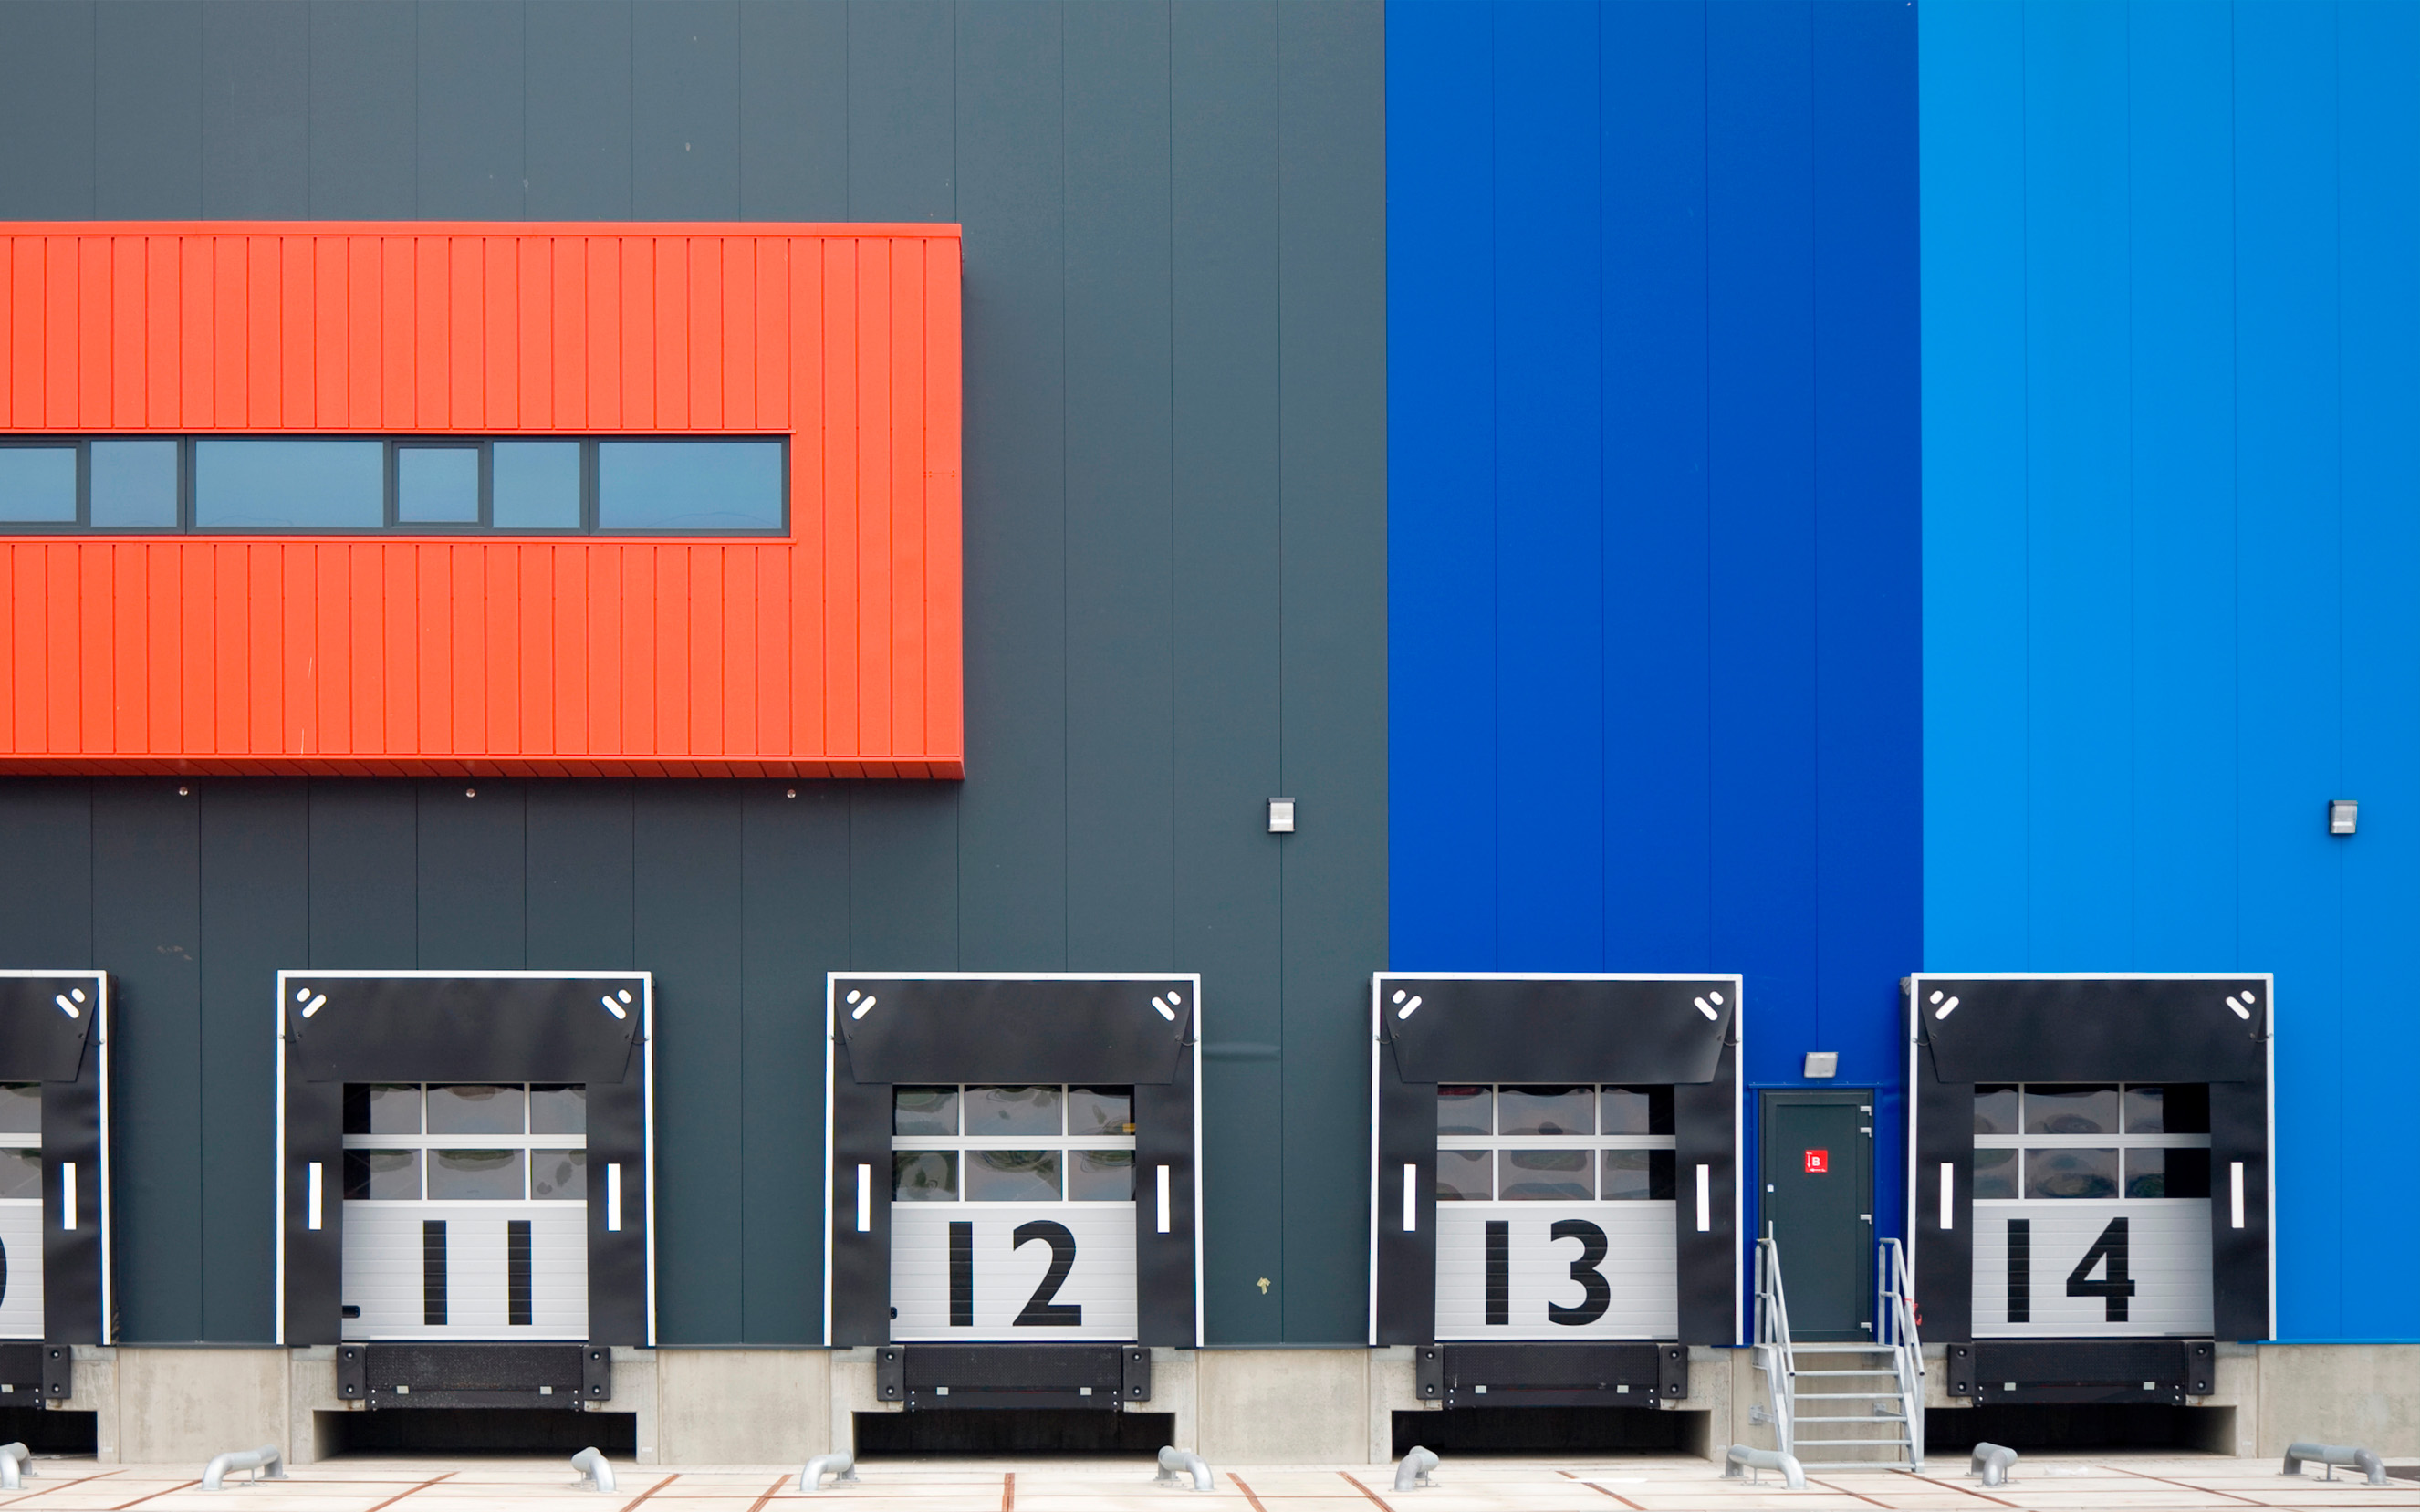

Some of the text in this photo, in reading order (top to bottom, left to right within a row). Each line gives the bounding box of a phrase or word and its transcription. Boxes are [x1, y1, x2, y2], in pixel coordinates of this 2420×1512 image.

[1812, 1156, 1820, 1166] B
[423, 1221, 532, 1325] 11
[950, 1220, 1081, 1326] 12
[1486, 1219, 1610, 1326] 13
[2008, 1217, 2135, 1322] 14
